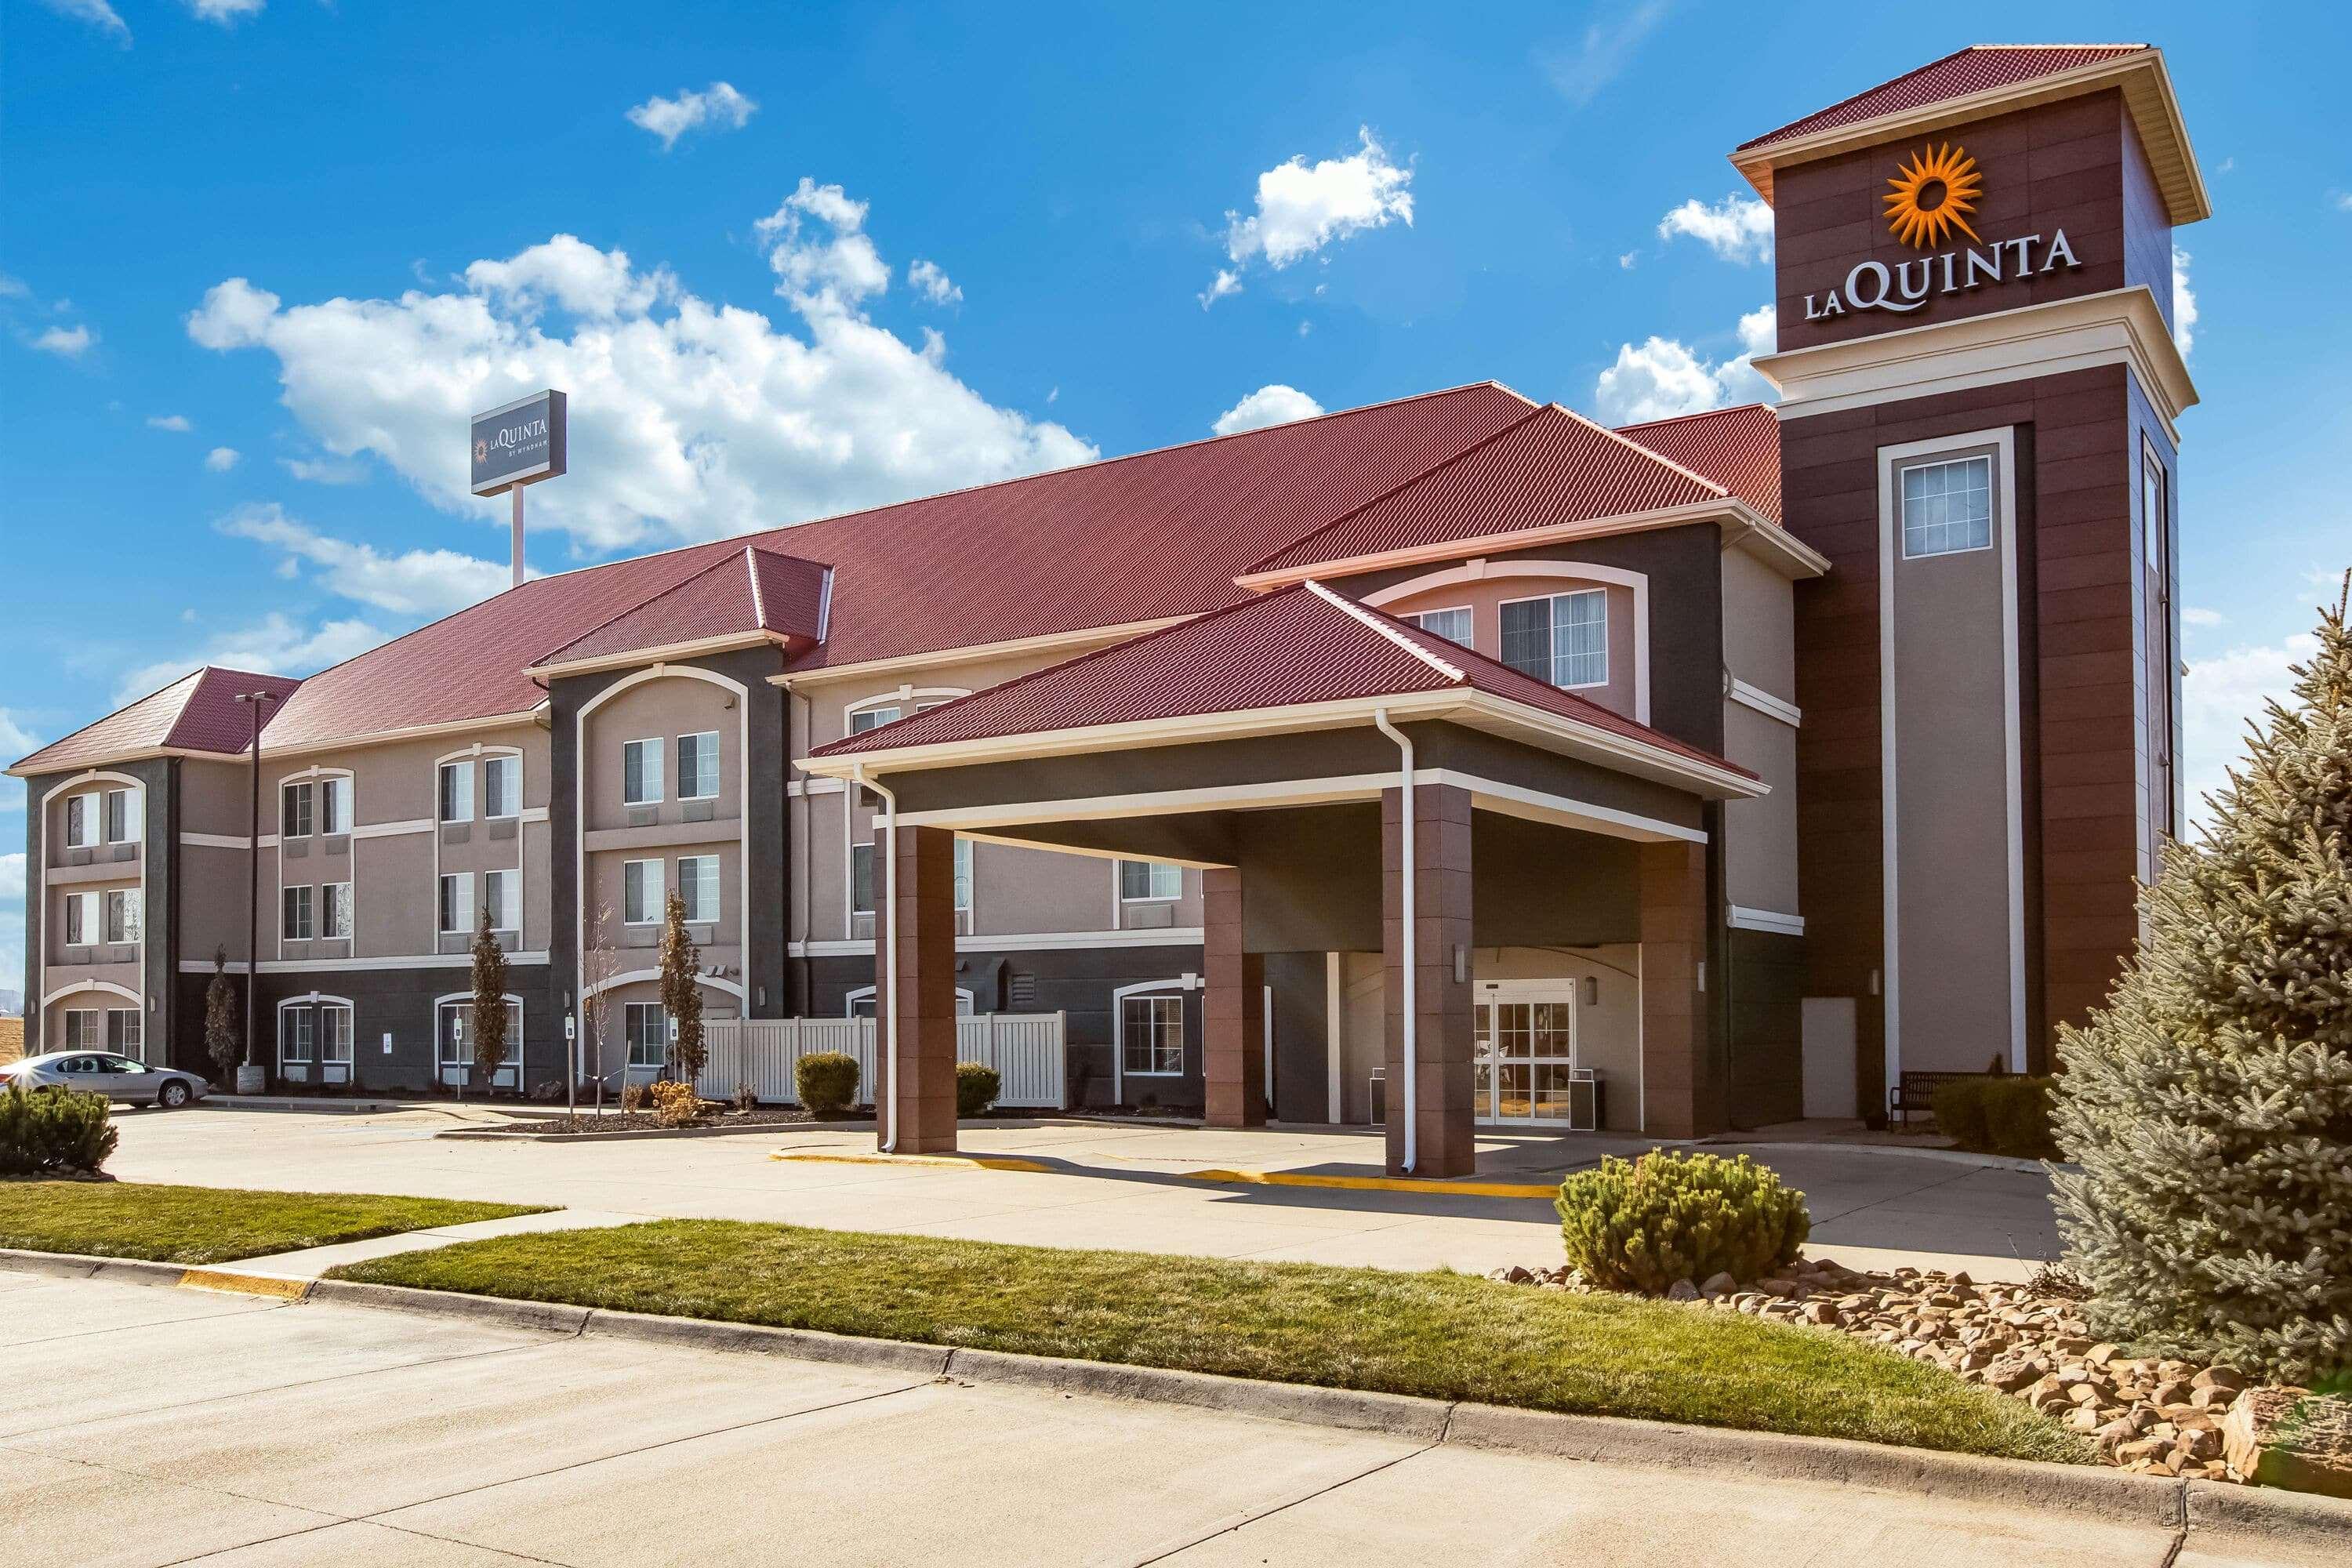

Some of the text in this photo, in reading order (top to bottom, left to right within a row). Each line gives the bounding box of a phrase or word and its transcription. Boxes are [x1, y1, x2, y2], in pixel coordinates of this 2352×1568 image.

[1804, 228, 2082, 320] LA QUINTA
[490, 419, 547, 451] LA QUINTA
